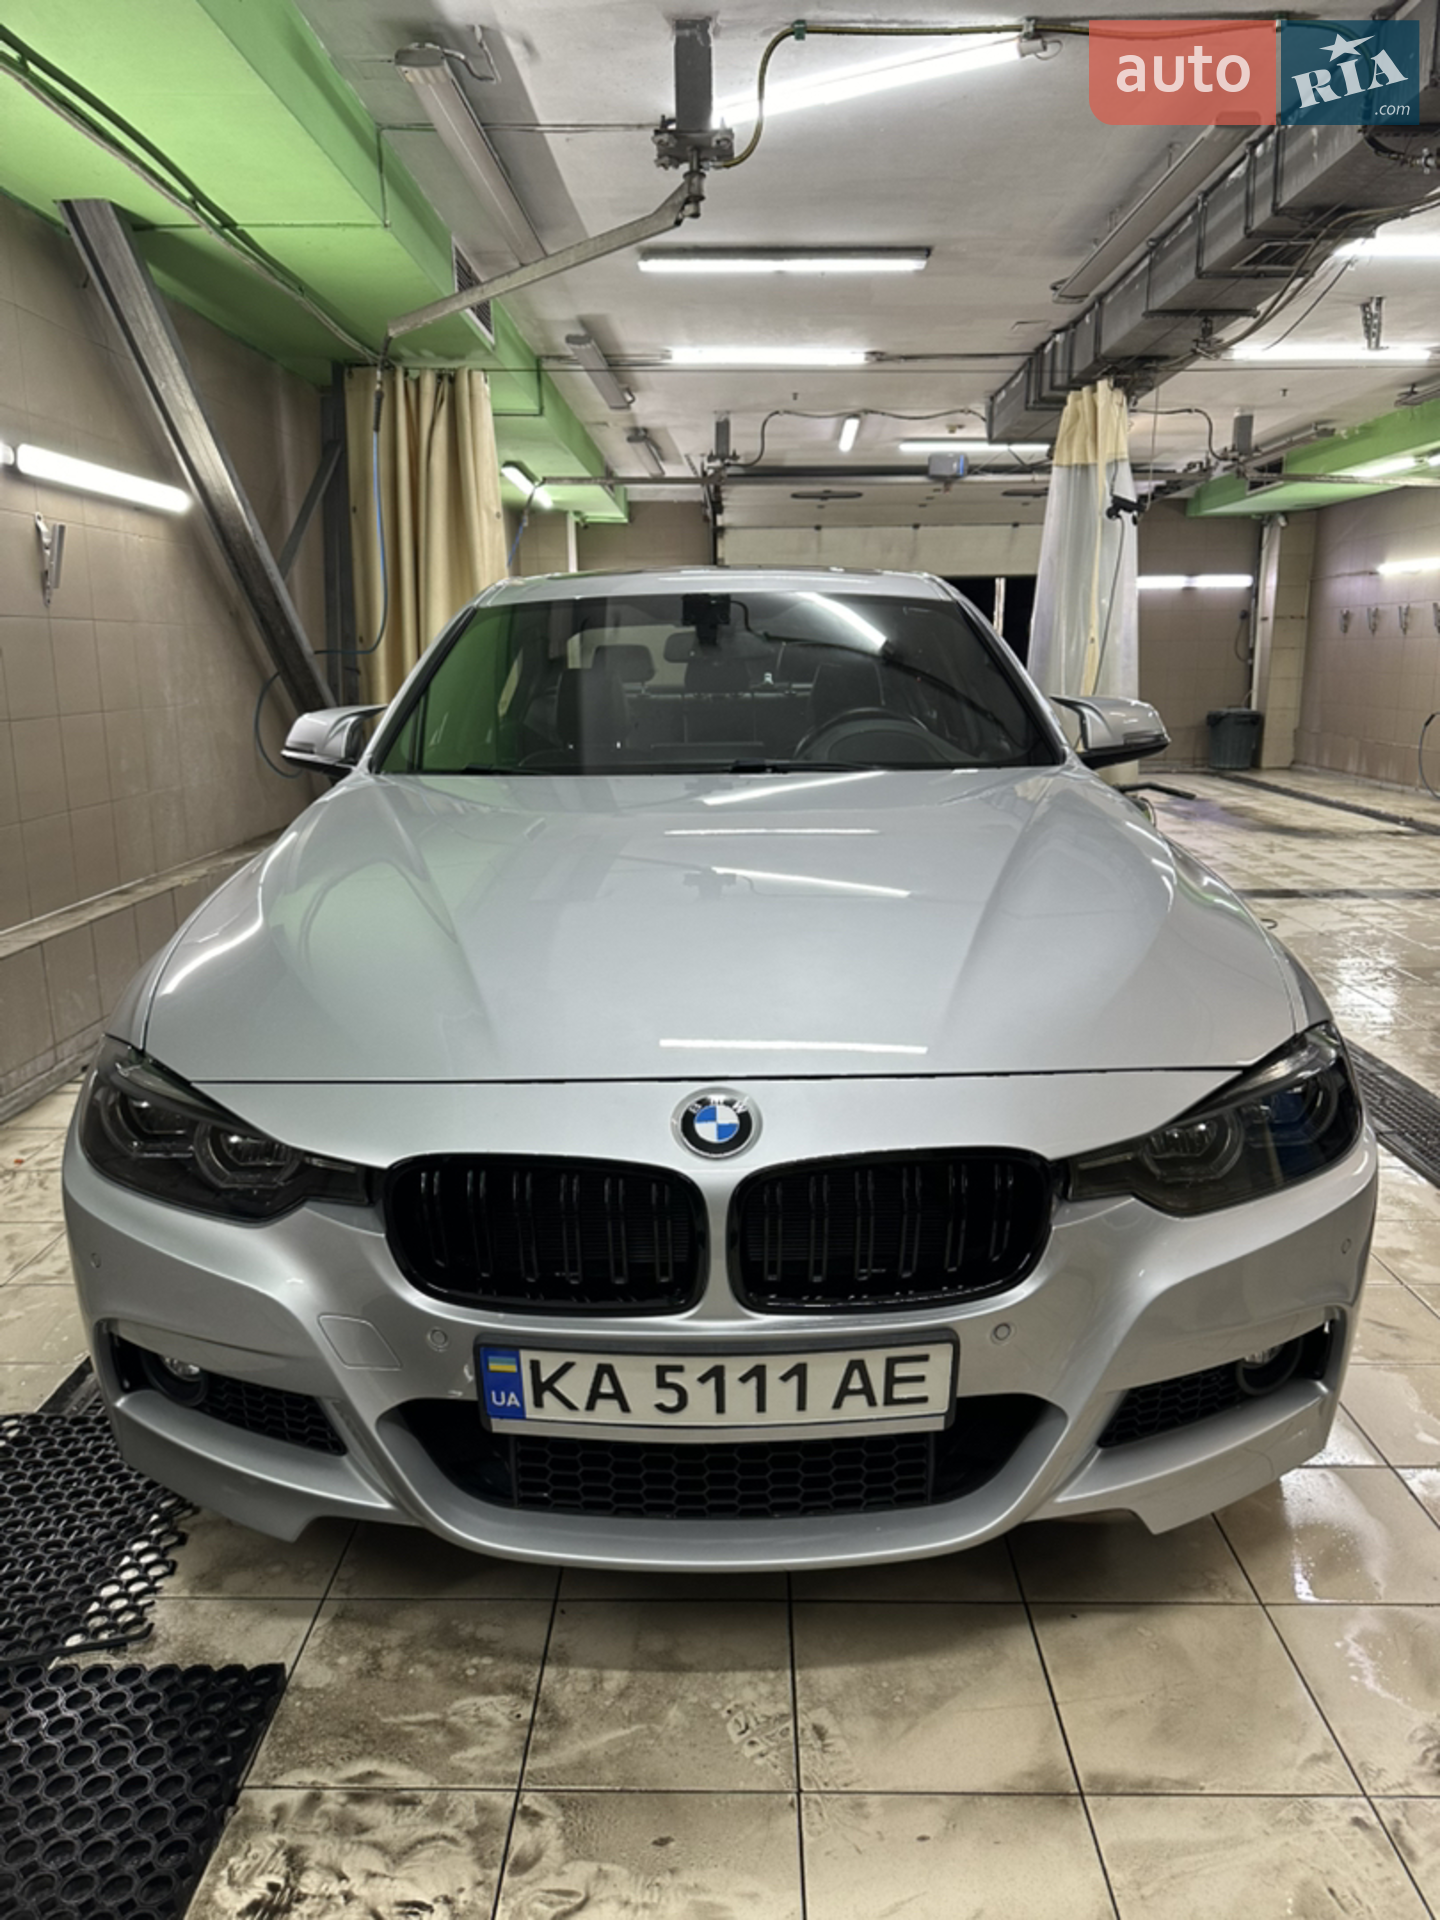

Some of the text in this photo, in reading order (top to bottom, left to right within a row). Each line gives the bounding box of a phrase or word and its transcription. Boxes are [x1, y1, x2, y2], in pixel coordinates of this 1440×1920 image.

[491, 1390, 521, 1408] UA
[529, 1354, 931, 1414] KA 5111 AE
